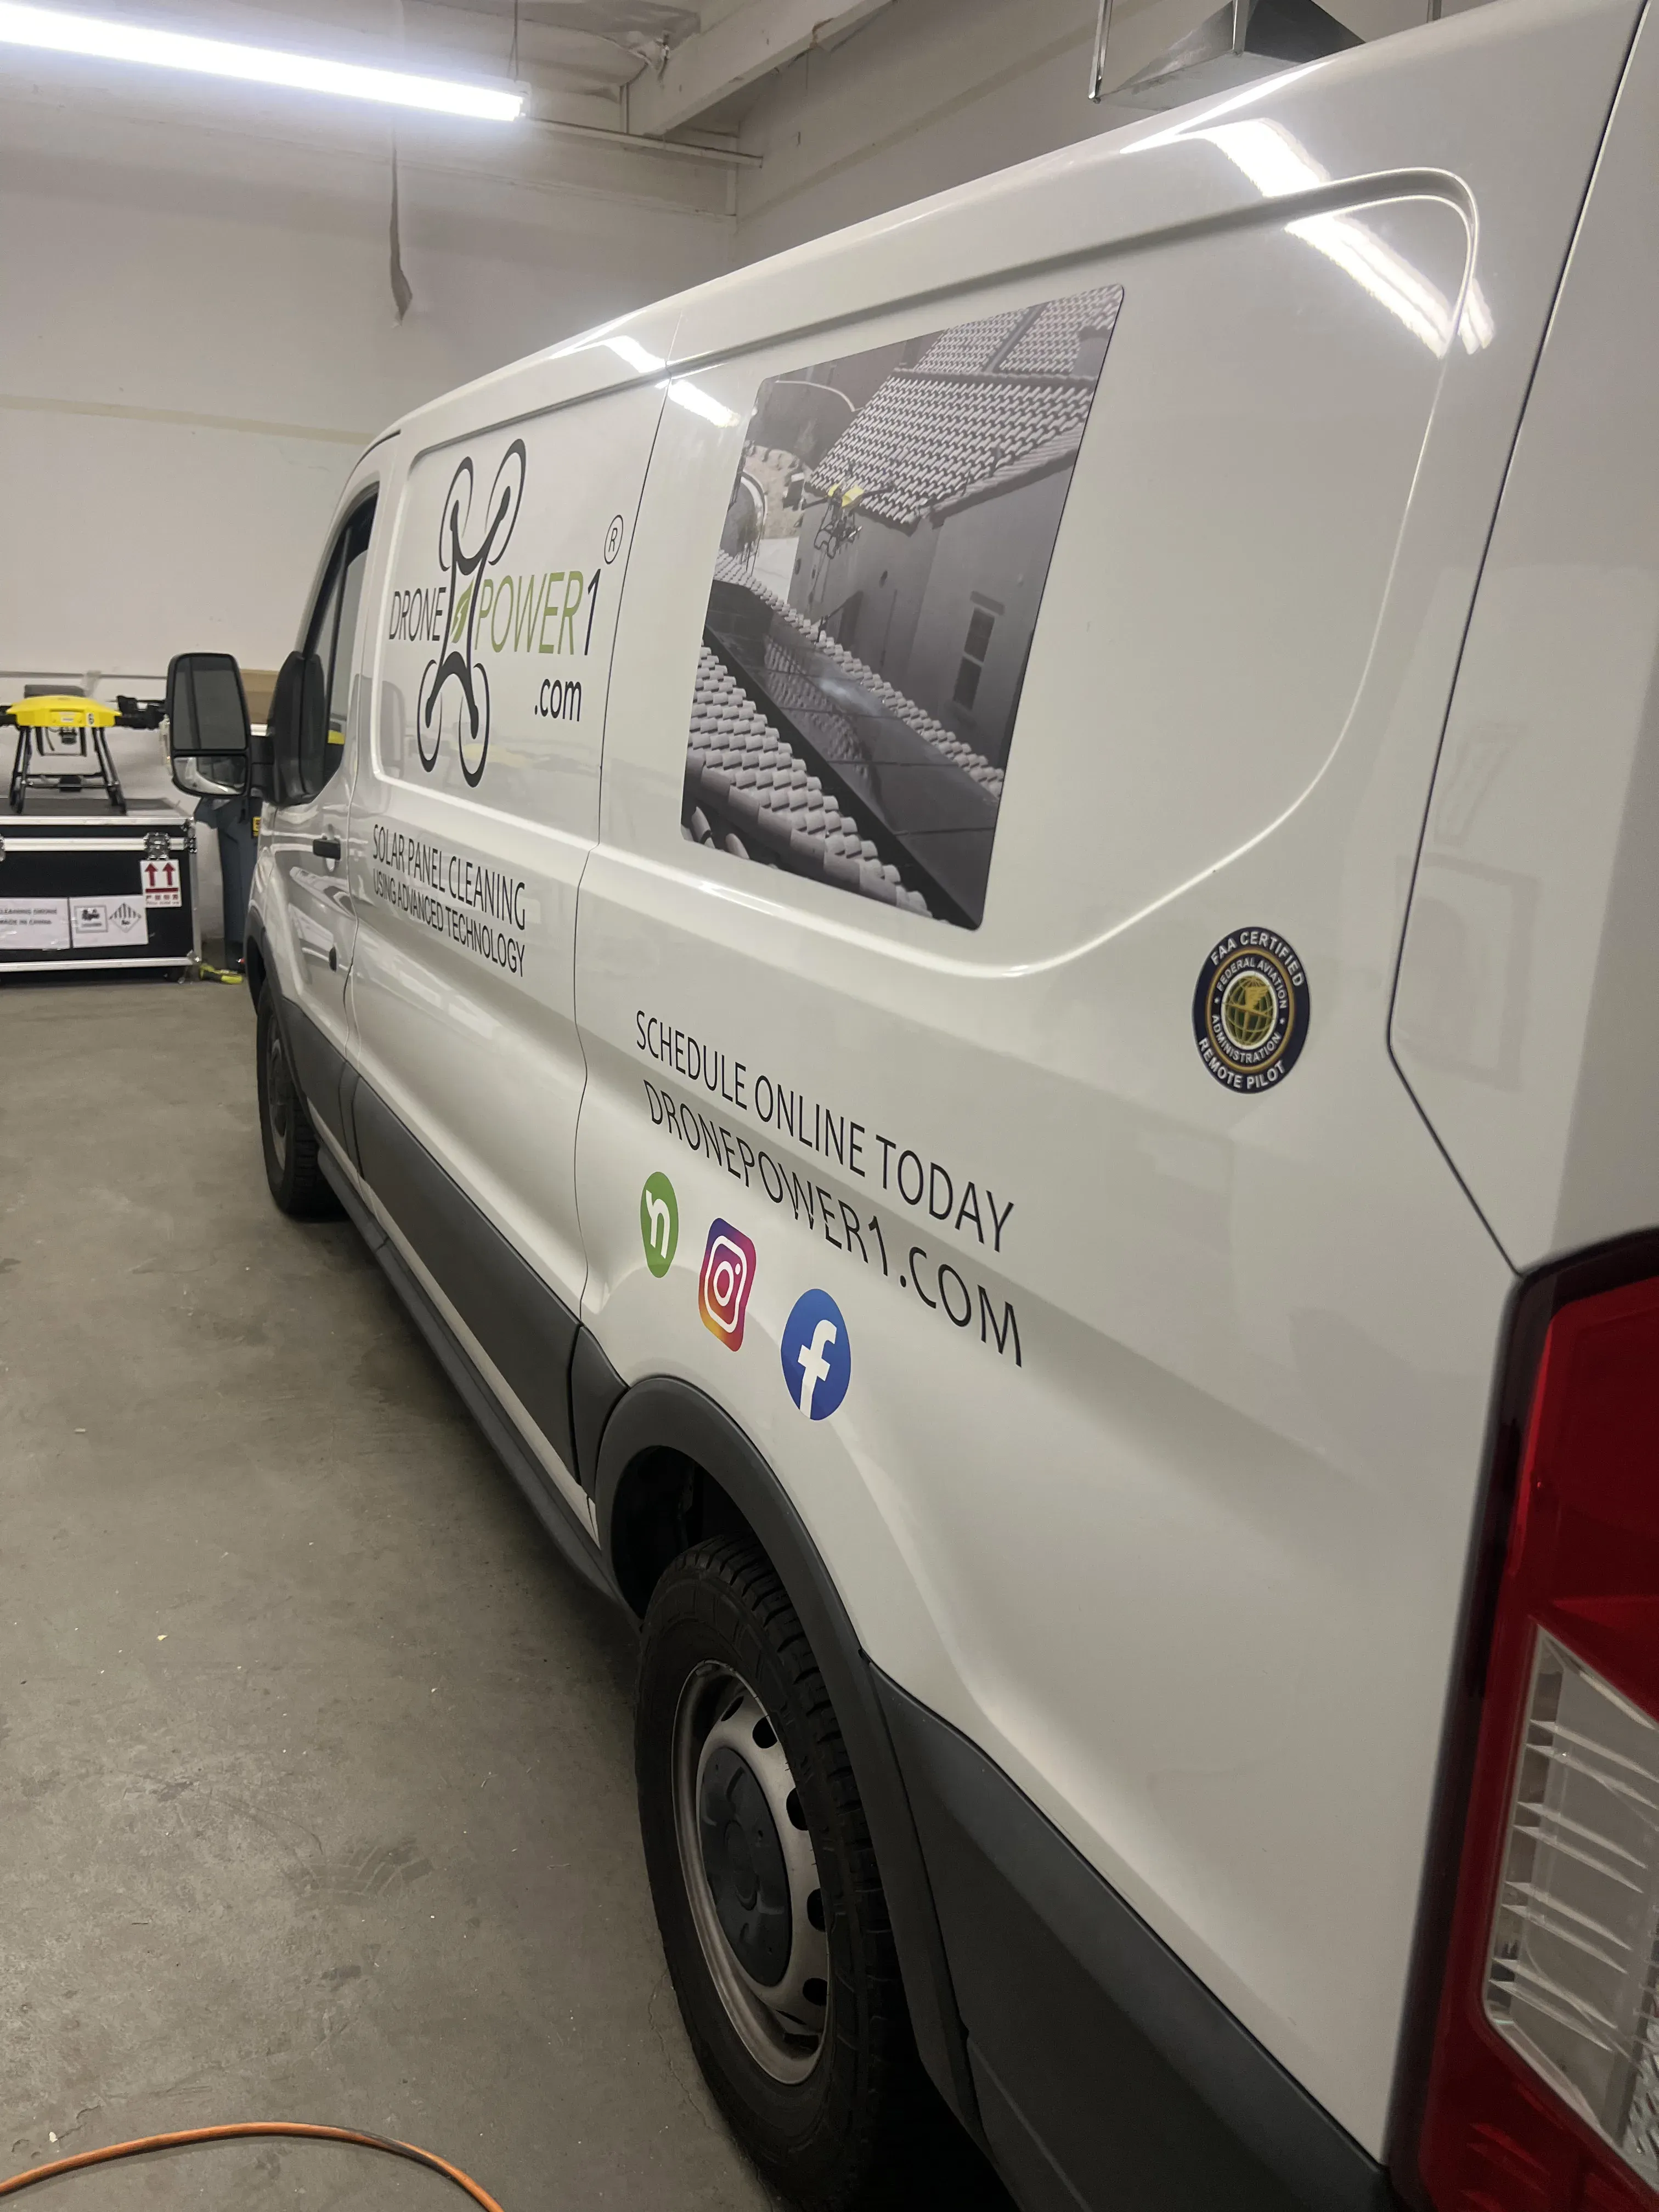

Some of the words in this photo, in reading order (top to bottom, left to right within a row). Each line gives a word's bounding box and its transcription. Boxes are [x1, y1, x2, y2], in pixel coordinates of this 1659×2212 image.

[388, 586, 447, 642] DRONE
[475, 568, 601, 656] POWER1
[534, 678, 582, 722] .com
[373, 824, 405, 873] SOLAR
[408, 838, 445, 893] PANEL
[448, 856, 525, 930] CLEANING
[373, 868, 396, 905] USING
[397, 881, 444, 932] ADVANCED
[445, 906, 525, 977] TECHNOLOGY
[1210, 938, 1238, 966] FAA
[1240, 931, 1304, 987] CERTIFIED
[1216, 957, 1255, 992] FEDERAL
[1256, 960, 1288, 1009] AVIATION
[1198, 1037, 1243, 1089] REMOTE
[1246, 1059, 1285, 1090] PILOT
[1211, 1014, 1282, 1064] ADMINISTRATION
[636, 1010, 747, 1110] SCHEDULE
[754, 1075, 866, 1178] ONLINE
[876, 1133, 1014, 1253] TODAY
[643, 1079, 1023, 1368] DRONEPOWER1.COM
